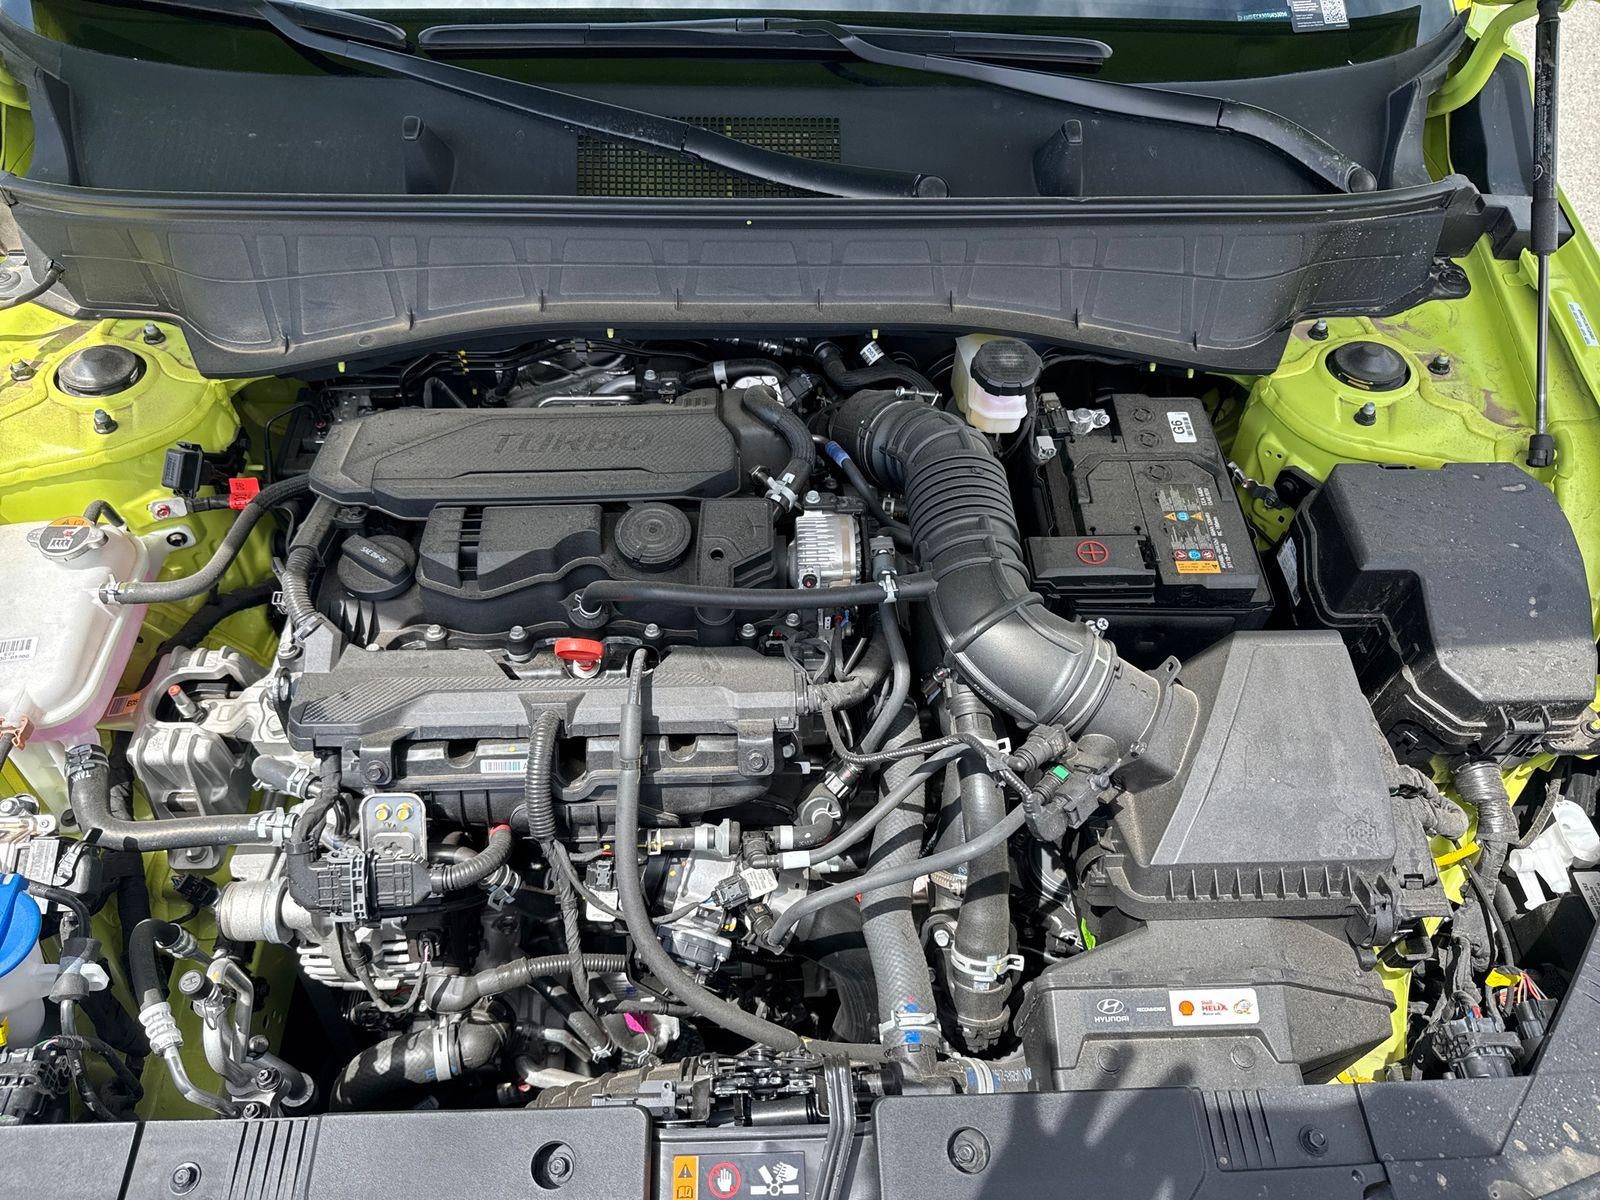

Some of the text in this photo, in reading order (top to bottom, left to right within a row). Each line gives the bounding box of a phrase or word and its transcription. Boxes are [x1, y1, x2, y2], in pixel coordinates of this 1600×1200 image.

[1171, 420, 1185, 434] G6
[494, 431, 654, 454] TURBO
[1201, 1003, 1228, 1012] HELIX
